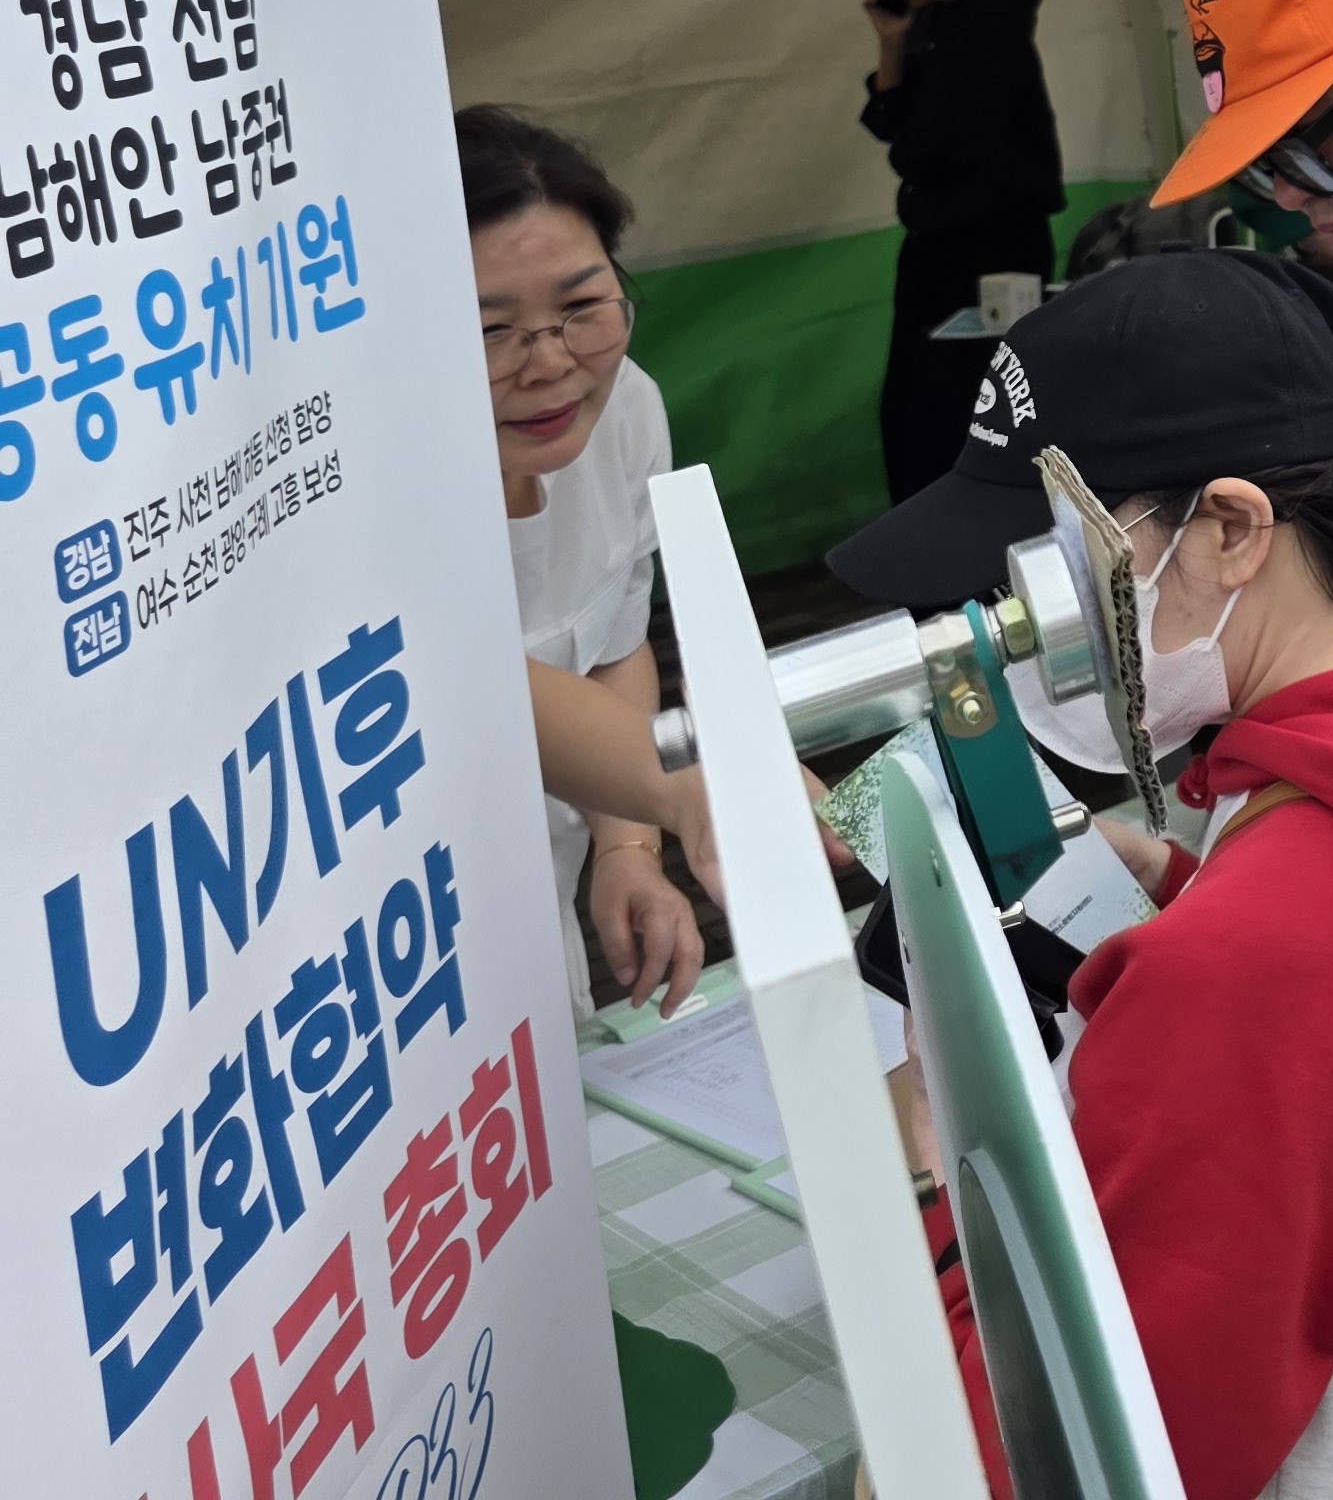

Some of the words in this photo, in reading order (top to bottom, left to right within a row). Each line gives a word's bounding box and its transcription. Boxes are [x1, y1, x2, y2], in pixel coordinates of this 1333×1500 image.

[0, 115, 183, 280] 남해안
[191, 77, 297, 218] 남중권
[61, 531, 115, 593] 경남
[123, 496, 171, 563] 진주
[177, 471, 213, 536] 사천
[214, 449, 244, 510] 남해
[243, 430, 264, 485] 하동
[264, 410, 293, 468] 산청
[293, 390, 332, 445] 함양
[71, 599, 125, 667] 전남
[136, 568, 179, 630] 여수
[183, 537, 220, 604] 순천
[220, 514, 247, 576] 광양
[247, 492, 271, 551] 구례
[270, 471, 301, 529] 고흥
[303, 448, 343, 505] 보성
[43, 615, 426, 1088] UN기후
[70, 841, 467, 1446] 변화협약
[384, 1017, 554, 1360] 총회
